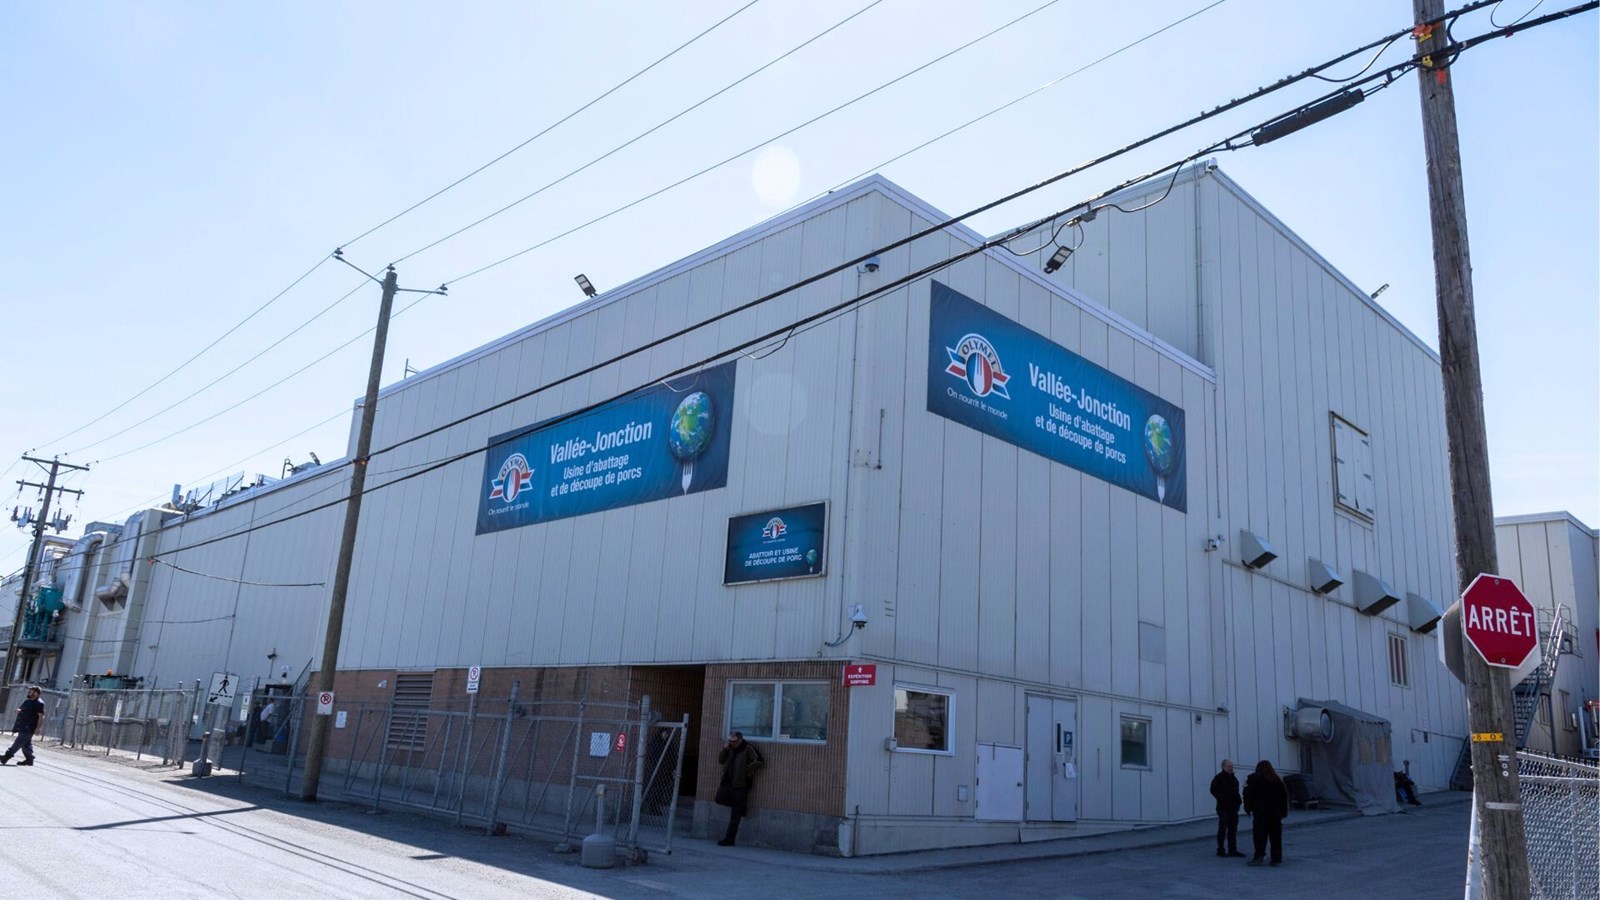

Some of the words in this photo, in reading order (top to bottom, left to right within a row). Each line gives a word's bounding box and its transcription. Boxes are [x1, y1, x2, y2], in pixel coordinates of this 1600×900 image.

[962, 340, 997, 369] OLYMEL
[947, 387, 958, 398] On
[958, 394, 980, 408] nourrit
[980, 401, 986, 411] le
[987, 406, 1008, 420] monde
[1029, 362, 1131, 432] Vallée-Jonction
[1035, 415, 1044, 429] et
[1046, 419, 1056, 434] de
[1058, 424, 1092, 450] découpe
[1094, 440, 1104, 454] de
[1105, 446, 1126, 464] porcs
[1049, 402, 1072, 425] Usine
[1074, 415, 1114, 444] d'abattage
[550, 421, 652, 464] Vallée-Jonction
[550, 484, 558, 497] et
[560, 482, 569, 495] de
[570, 476, 603, 493] découpe
[605, 472, 615, 484] de
[617, 466, 642, 485] porcs
[564, 465, 584, 480] Usine
[585, 454, 629, 474] d'abattage
[749, 550, 774, 559] ABATTOIR
[782, 547, 799, 555] USINE
[753, 557, 777, 566] DÉCOUPE
[1468, 604, 1532, 637] ARRÊT
